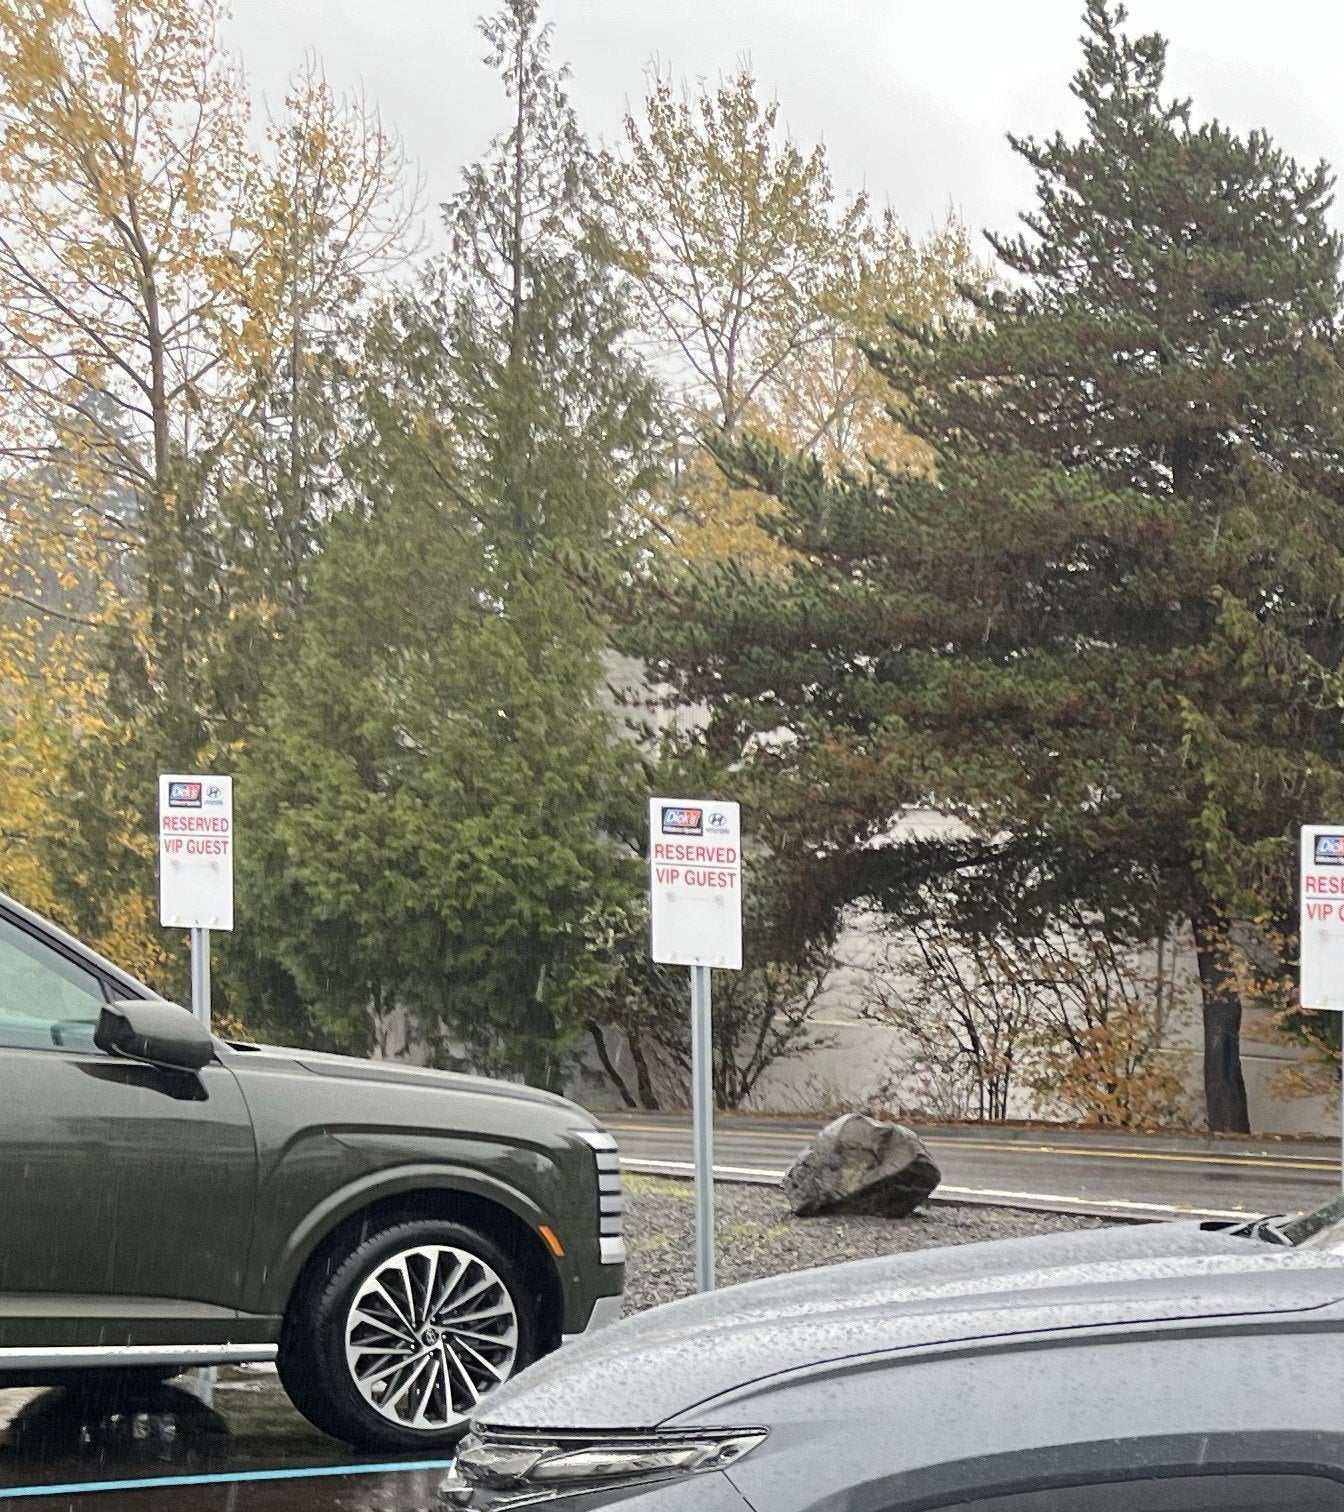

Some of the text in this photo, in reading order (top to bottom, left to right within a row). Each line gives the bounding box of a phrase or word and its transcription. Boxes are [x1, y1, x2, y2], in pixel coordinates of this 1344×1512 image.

[162, 815, 229, 833] RESERVED
[163, 838, 229, 855] VIP GUEST
[654, 843, 737, 864] RESERVED
[655, 867, 737, 888] VIP GUEST
[1306, 902, 1333, 921] VIP
